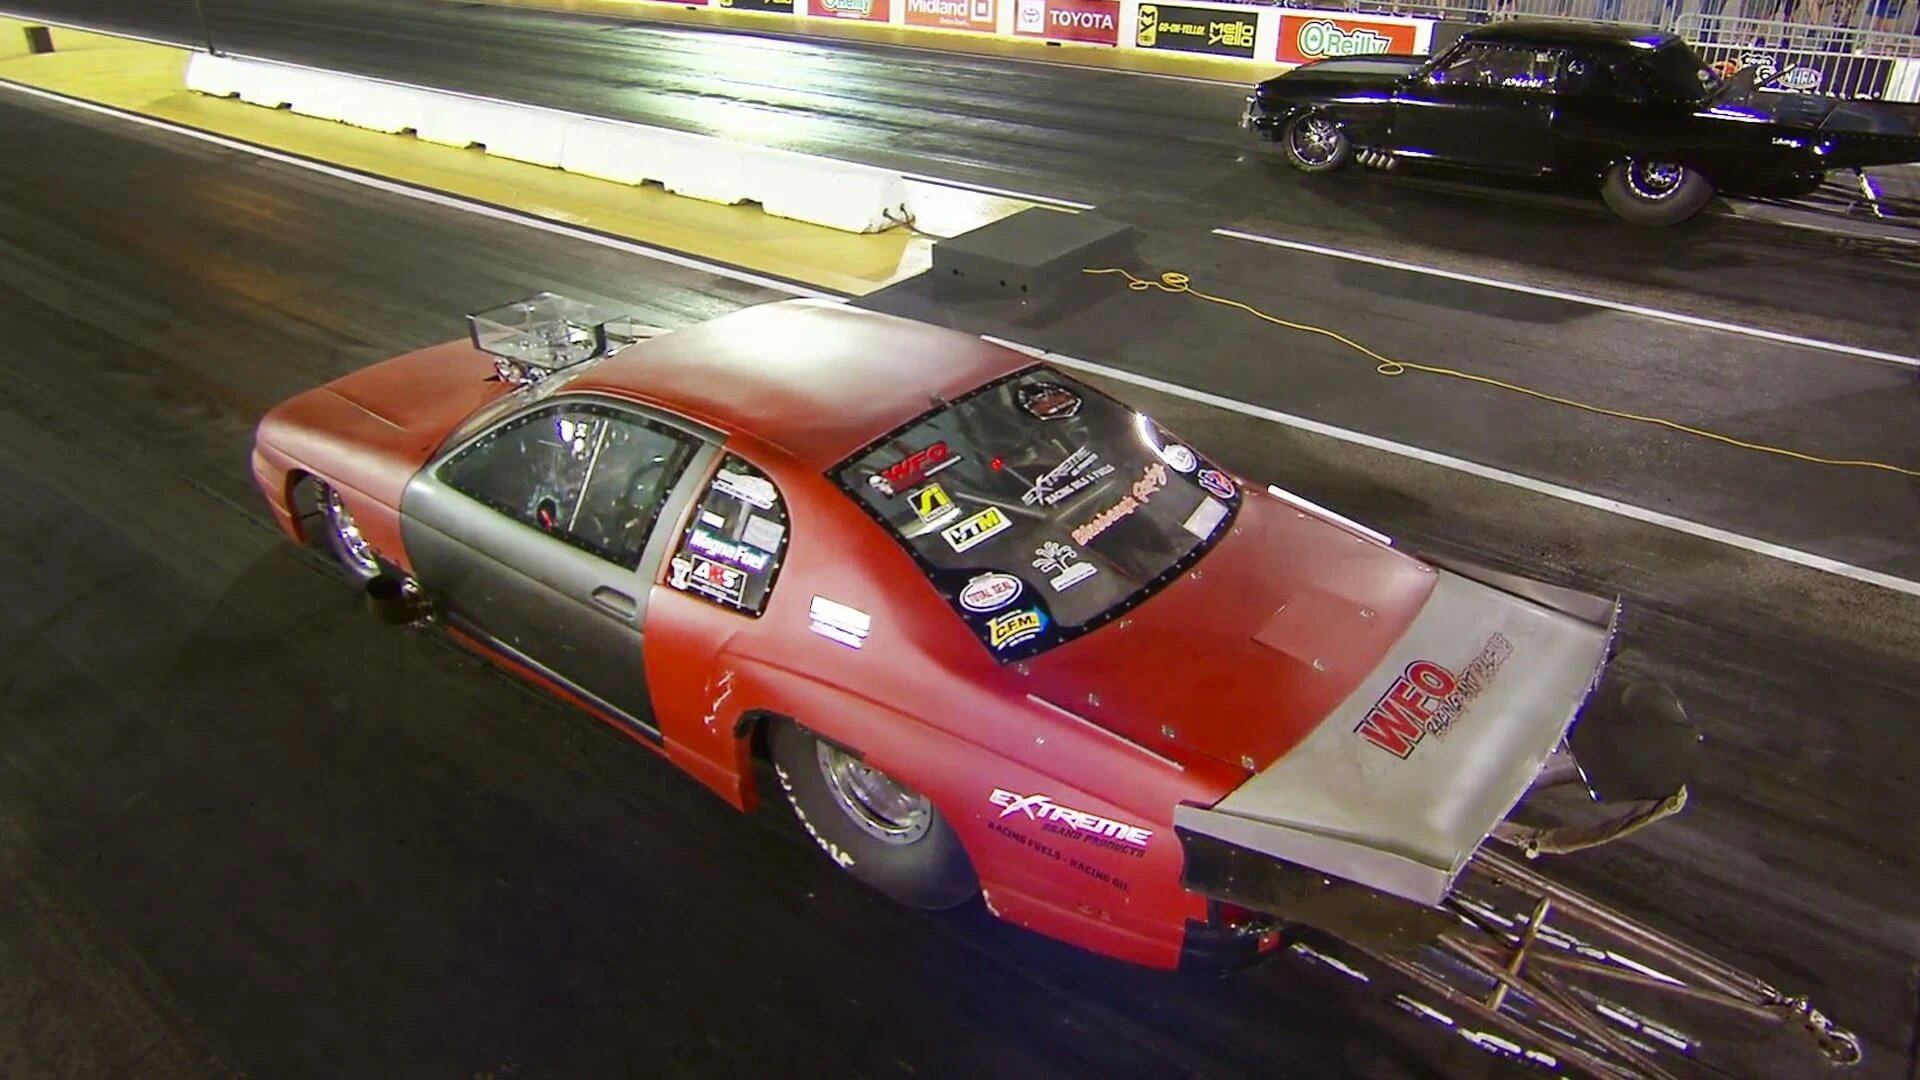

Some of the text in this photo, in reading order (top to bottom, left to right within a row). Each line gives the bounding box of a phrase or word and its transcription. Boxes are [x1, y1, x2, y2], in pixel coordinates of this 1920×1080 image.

[908, 0, 967, 16] Midland
[1049, 9, 1114, 30] TOYOTA
[1302, 23, 1388, 56] O'Reilly
[882, 441, 949, 485] WFO
[688, 528, 768, 571] MagnaFuel
[1354, 659, 1457, 760] WFO
[989, 787, 1153, 847] EXTREME
[988, 821, 1026, 845] RACING
[1027, 839, 1061, 861] FUELS
[1069, 858, 1110, 884] RACING
[1111, 877, 1130, 893] OIL
[1083, 834, 1146, 859] PRODUCTS
